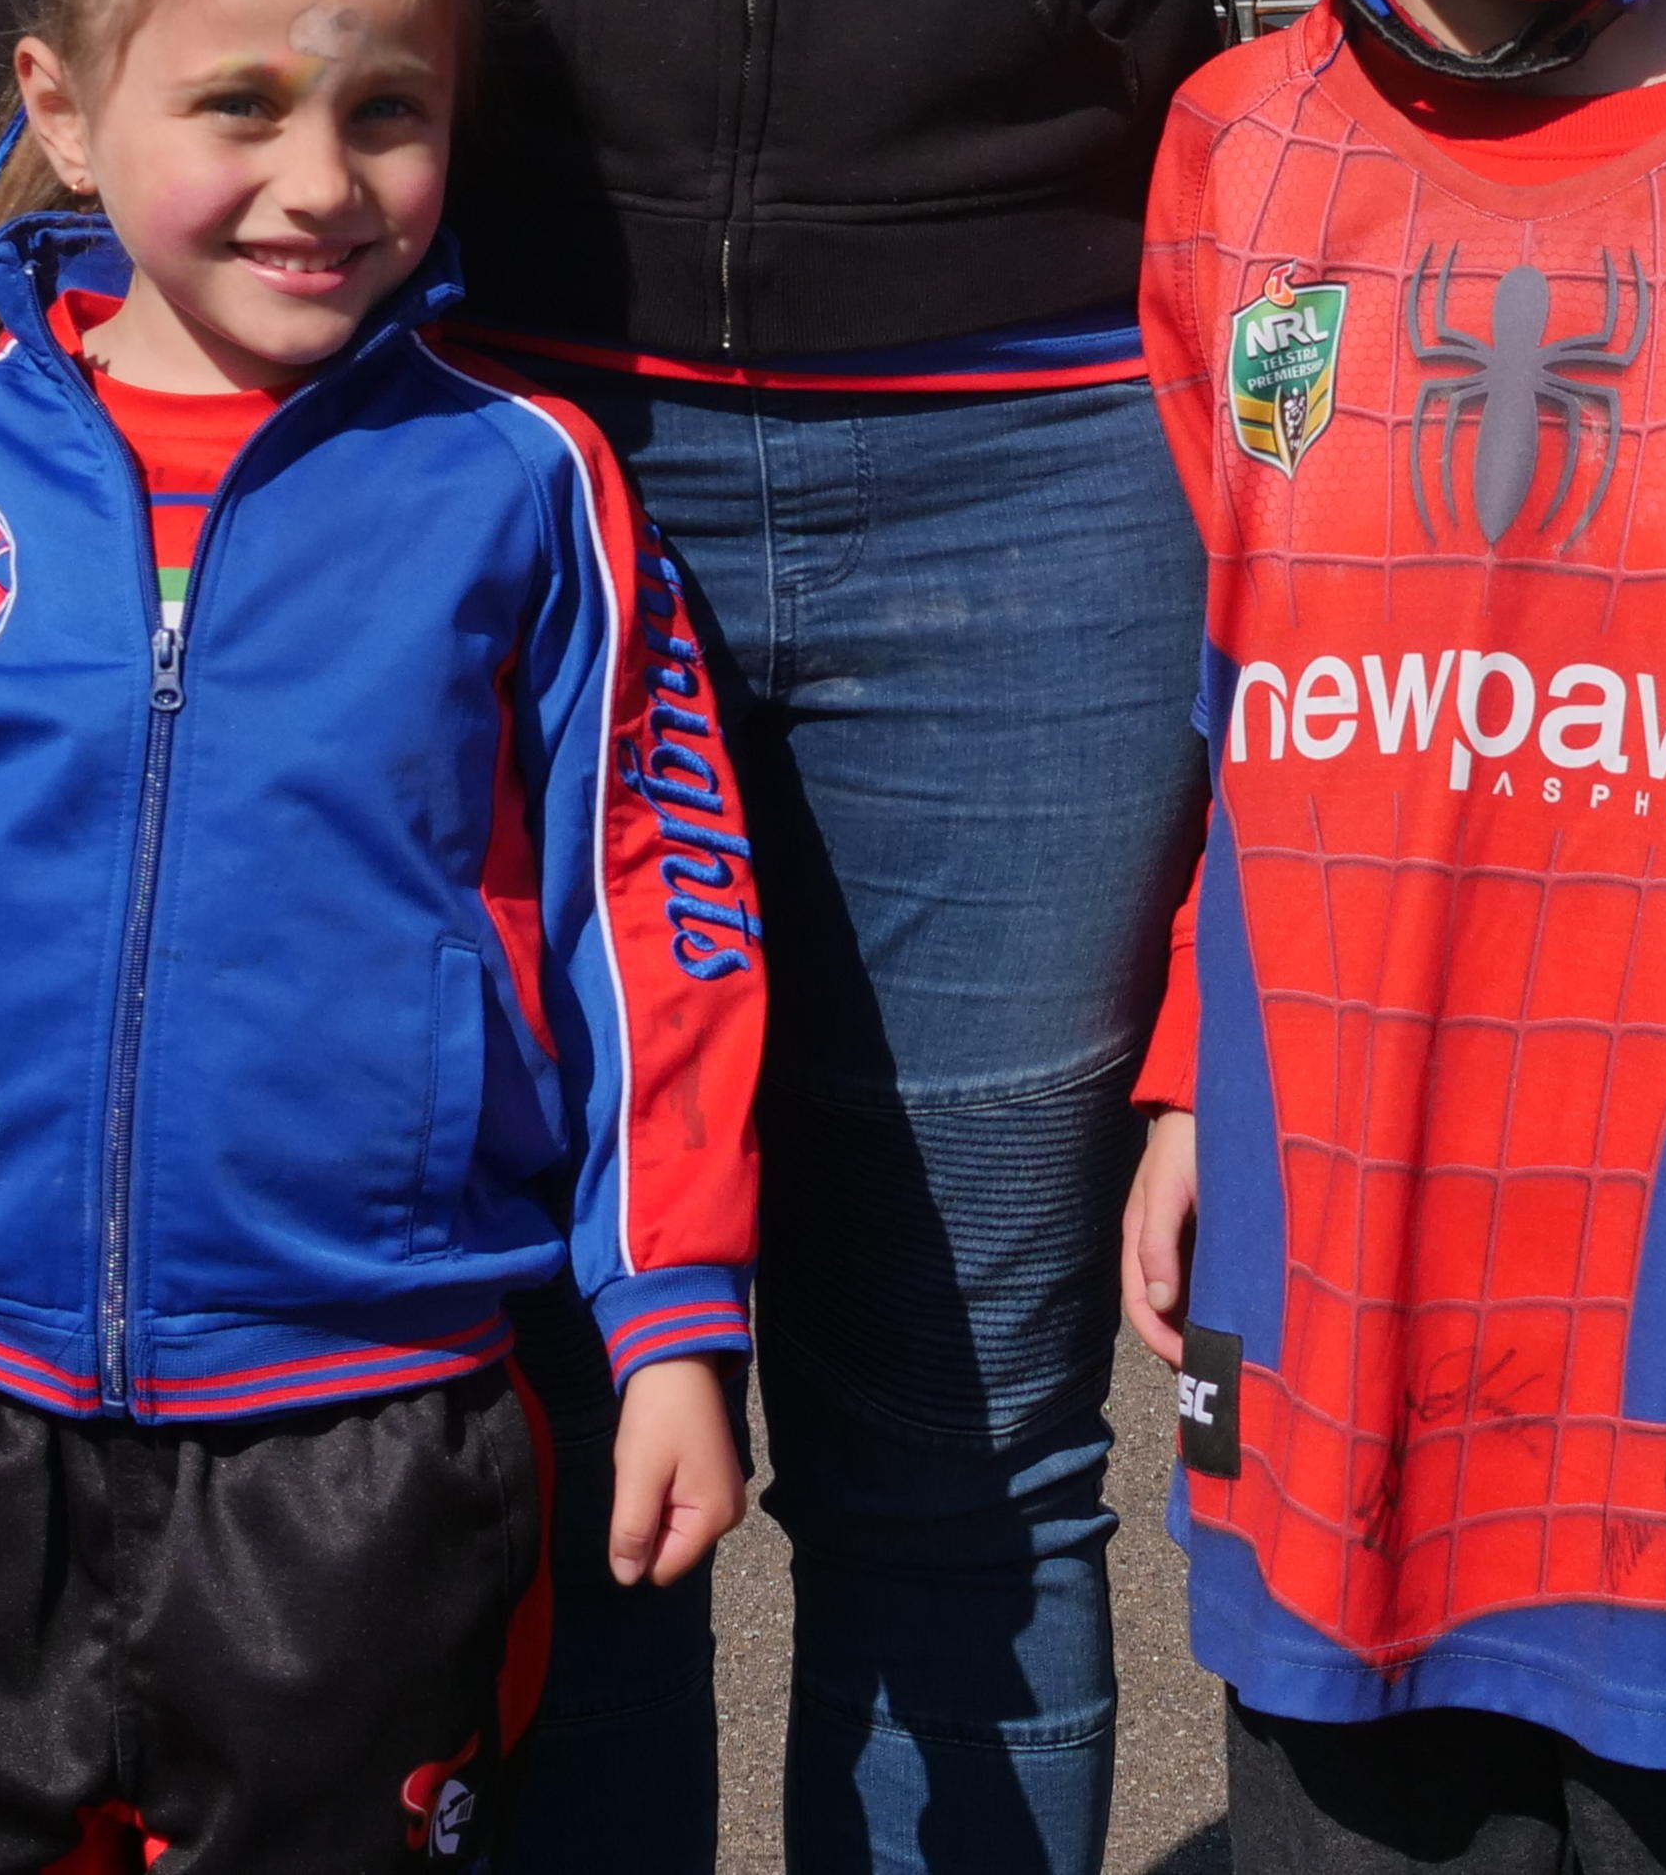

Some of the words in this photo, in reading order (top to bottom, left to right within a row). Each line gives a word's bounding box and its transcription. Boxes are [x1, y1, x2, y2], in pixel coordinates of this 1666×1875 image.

[1246, 306, 1329, 359] NRL
[1247, 358, 1325, 391] PREMIERSHIP
[1261, 346, 1319, 371] TELSTRA
[1178, 1373, 1219, 1425] SC
